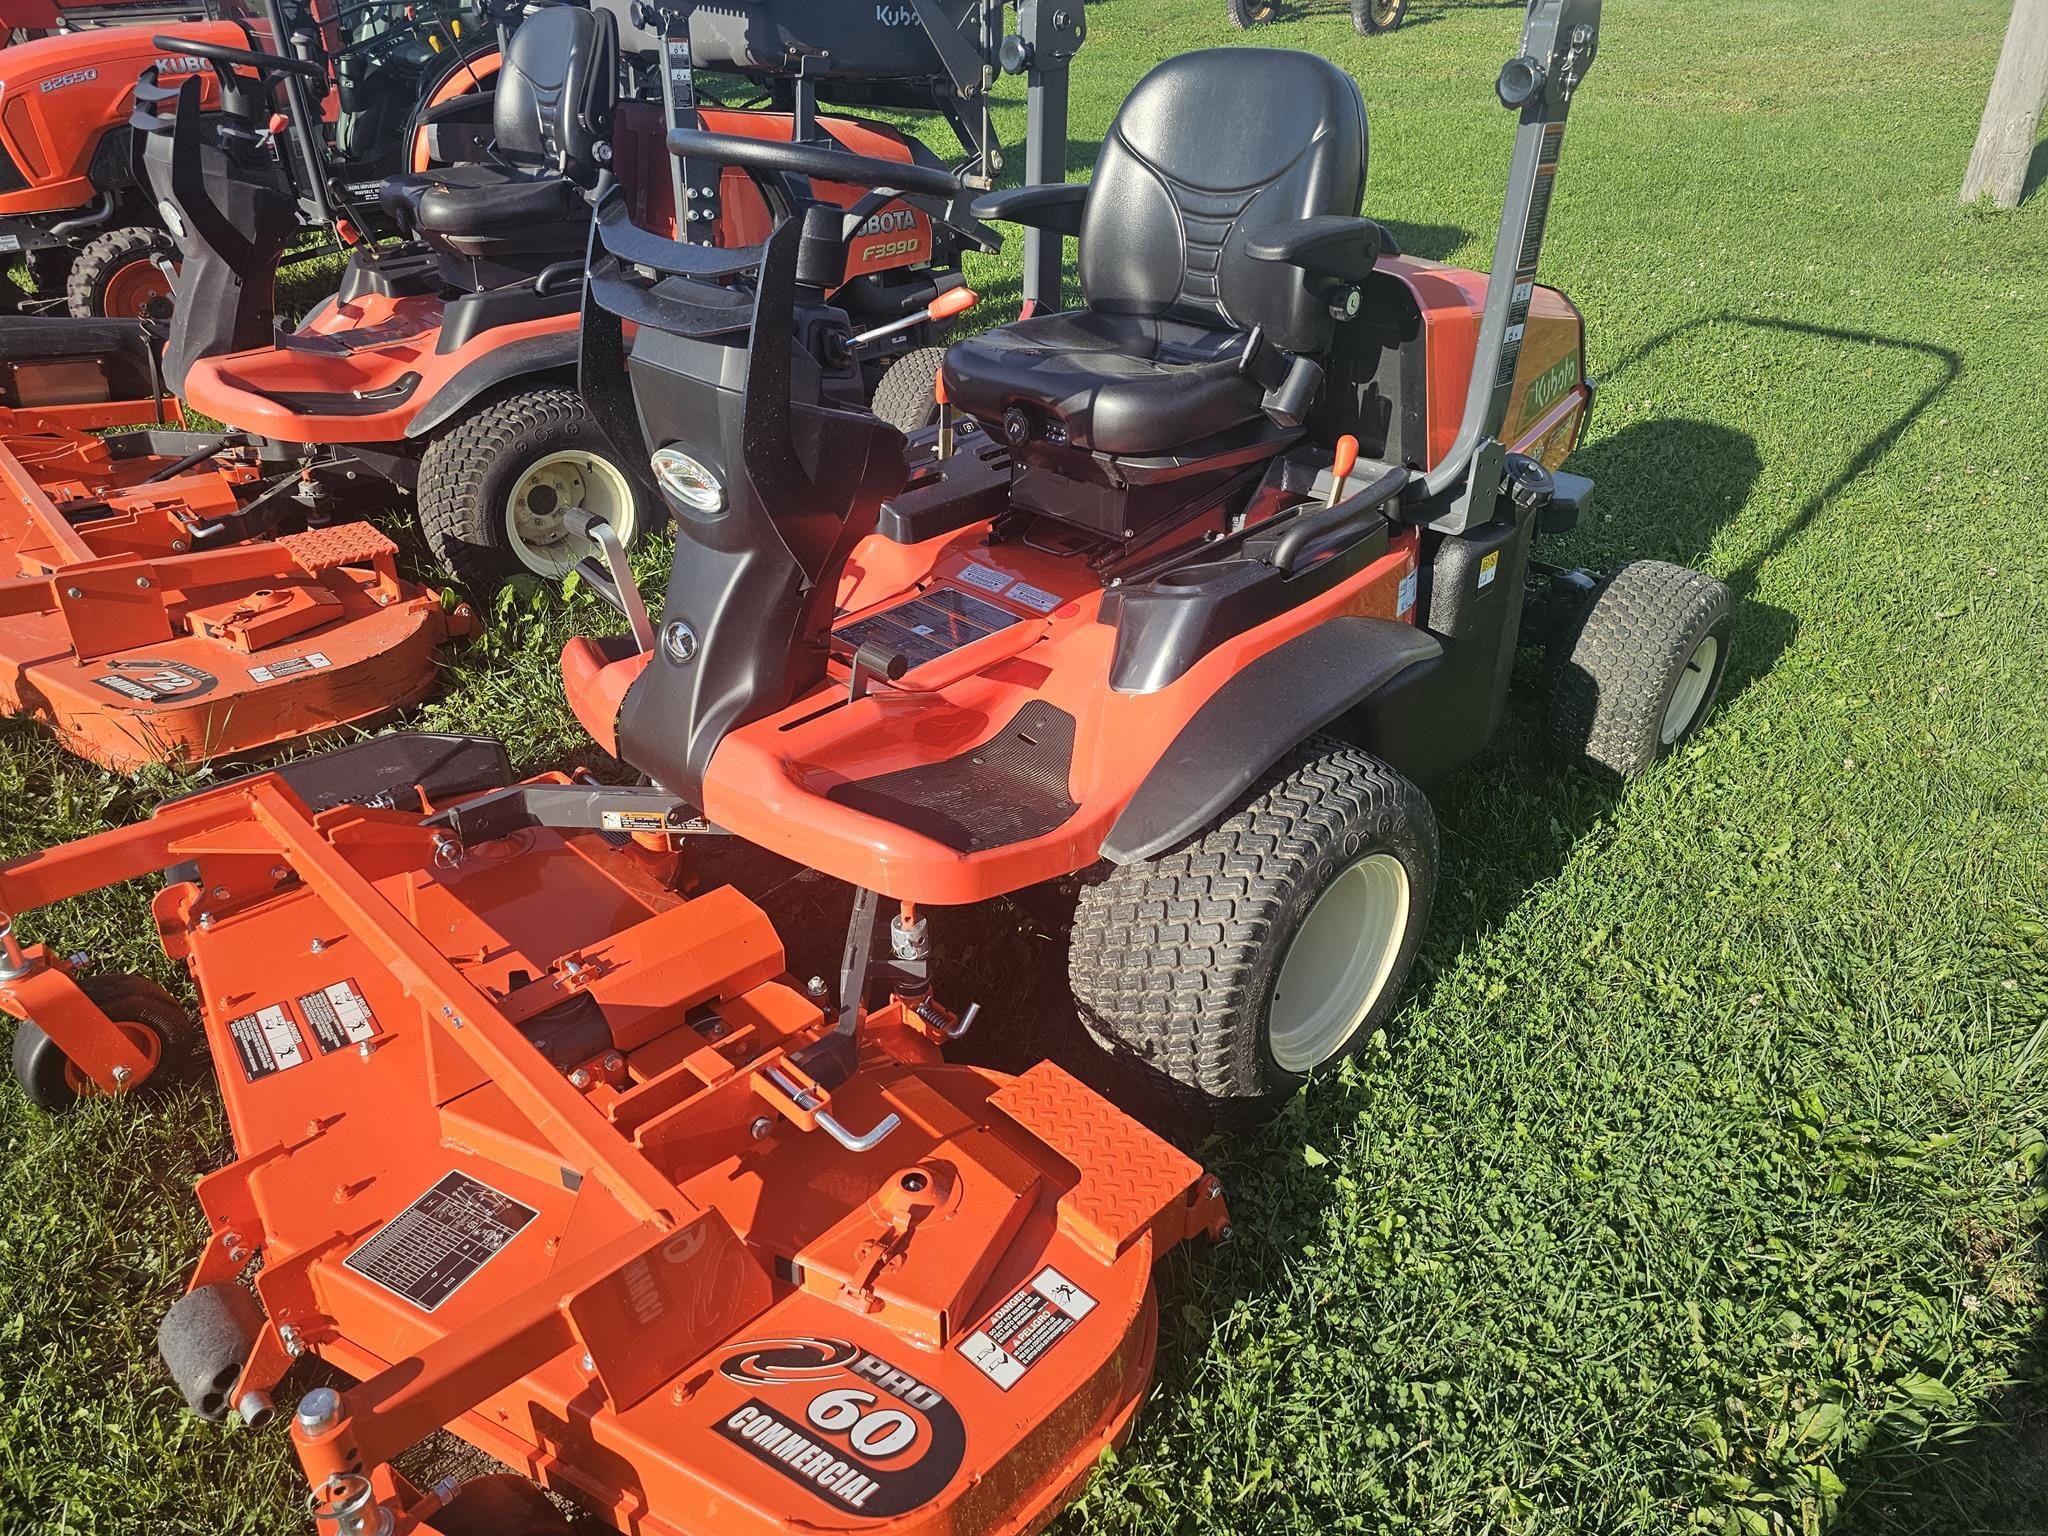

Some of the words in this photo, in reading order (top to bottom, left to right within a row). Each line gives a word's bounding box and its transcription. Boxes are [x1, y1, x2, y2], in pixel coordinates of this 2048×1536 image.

[876, 5, 921, 26] Kubo
[41, 69, 98, 93] B2650
[862, 239, 919, 261] F3990
[1535, 357, 1575, 407] Kubota
[139, 671, 193, 691] 72
[996, 1290, 1028, 1318] DANGER
[1017, 1310, 1051, 1342] PELIGRO
[851, 1354, 943, 1411] PRO
[806, 1388, 918, 1457] 60
[727, 1406, 881, 1508] COMMERCIAL
